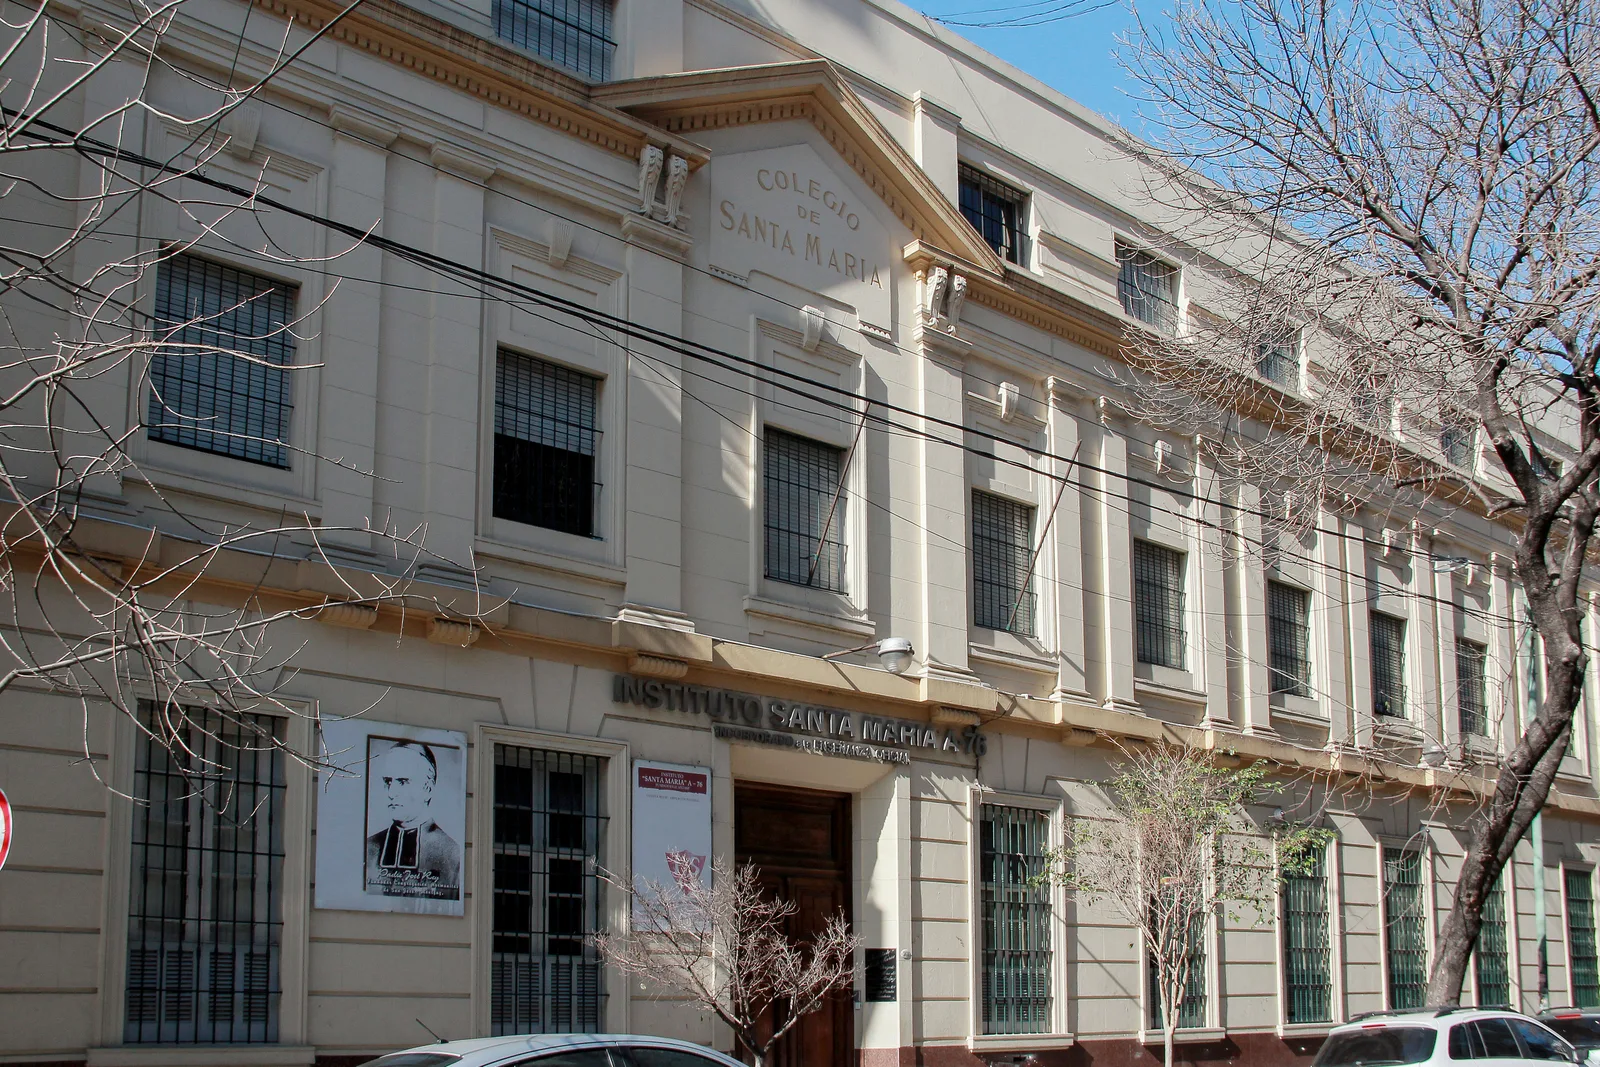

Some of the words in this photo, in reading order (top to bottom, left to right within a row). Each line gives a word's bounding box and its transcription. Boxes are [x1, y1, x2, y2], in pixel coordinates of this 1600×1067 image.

[757, 168, 860, 231] COLEGIO
[797, 205, 820, 226] DE
[719, 199, 795, 256] SANTA
[804, 232, 883, 290] MARIA
[612, 675, 763, 724] INSTITUTO
[769, 700, 854, 738] SANTA
[860, 713, 937, 750] MARIA
[714, 726, 794, 748] INCORPORADO
